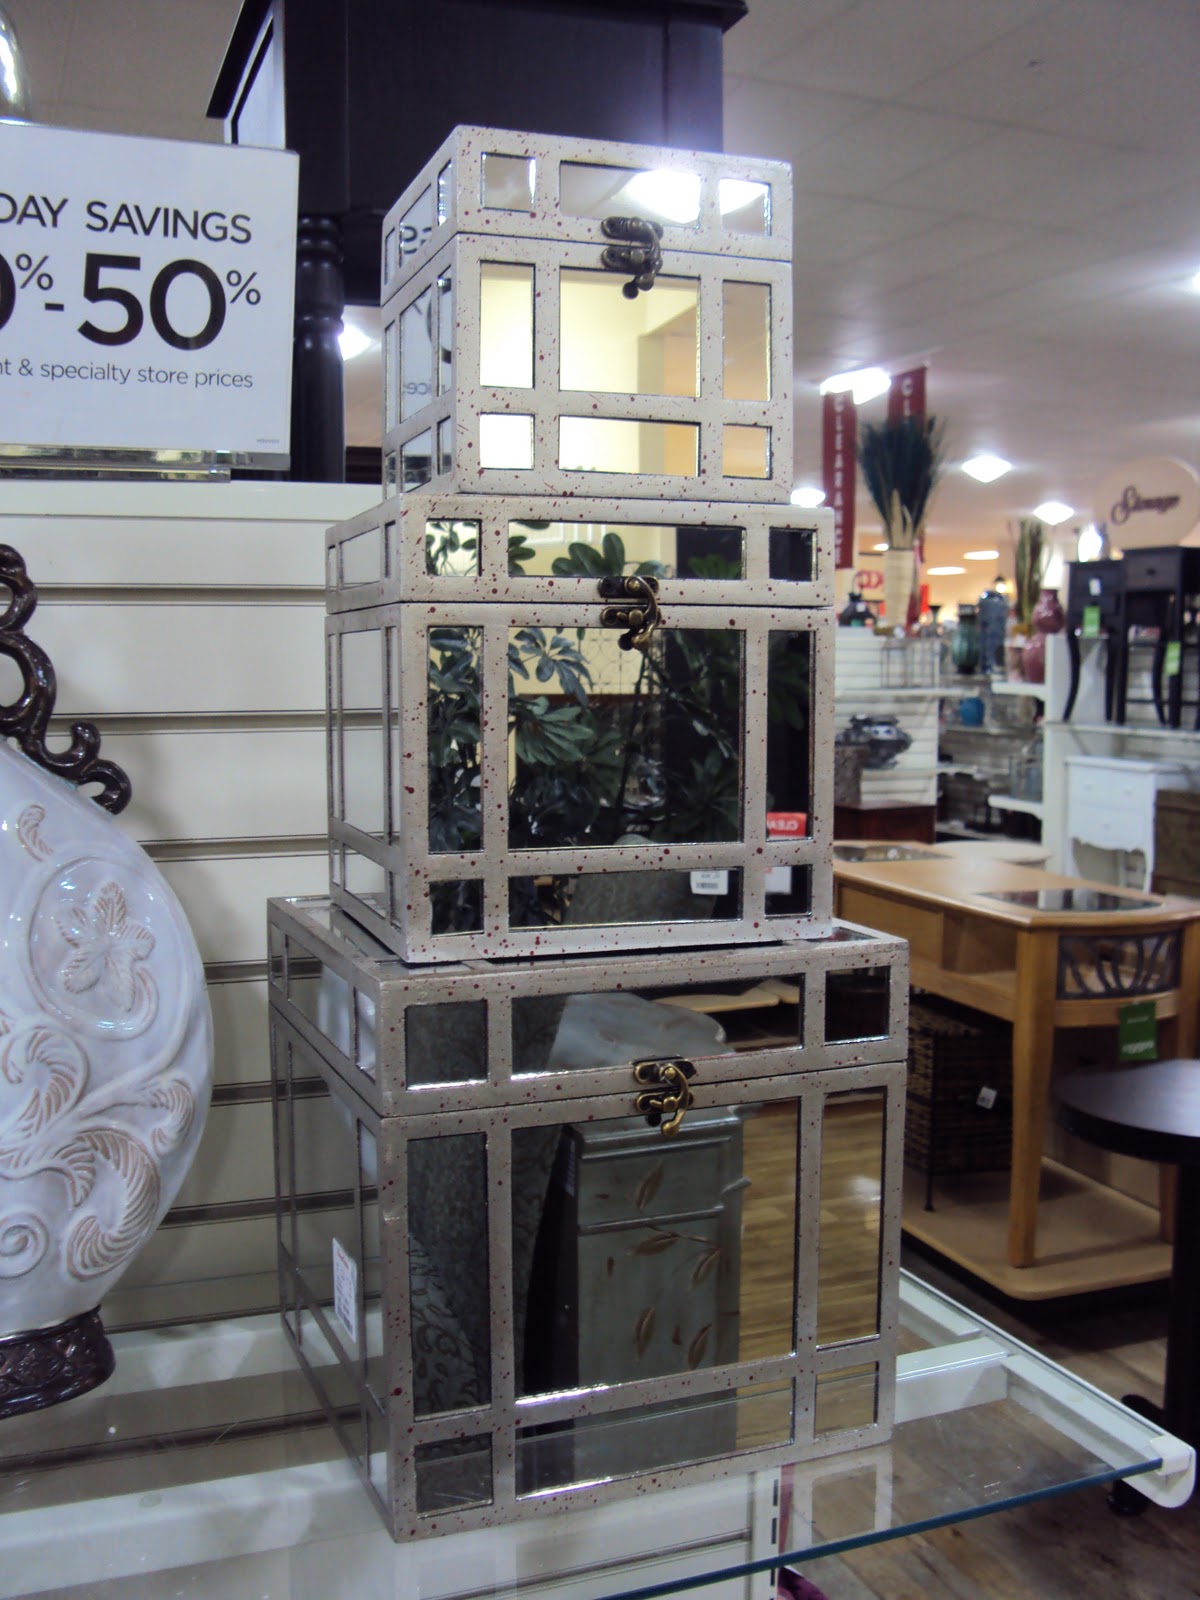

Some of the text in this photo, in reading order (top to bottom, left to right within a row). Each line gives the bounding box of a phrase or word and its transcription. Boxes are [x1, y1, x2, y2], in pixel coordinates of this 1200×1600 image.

[85, 200, 252, 245] SAVINGS
[18, 358, 34, 377] &
[40, 362, 131, 385] specialty
[137, 366, 189, 385] store
[194, 368, 254, 389] prices
